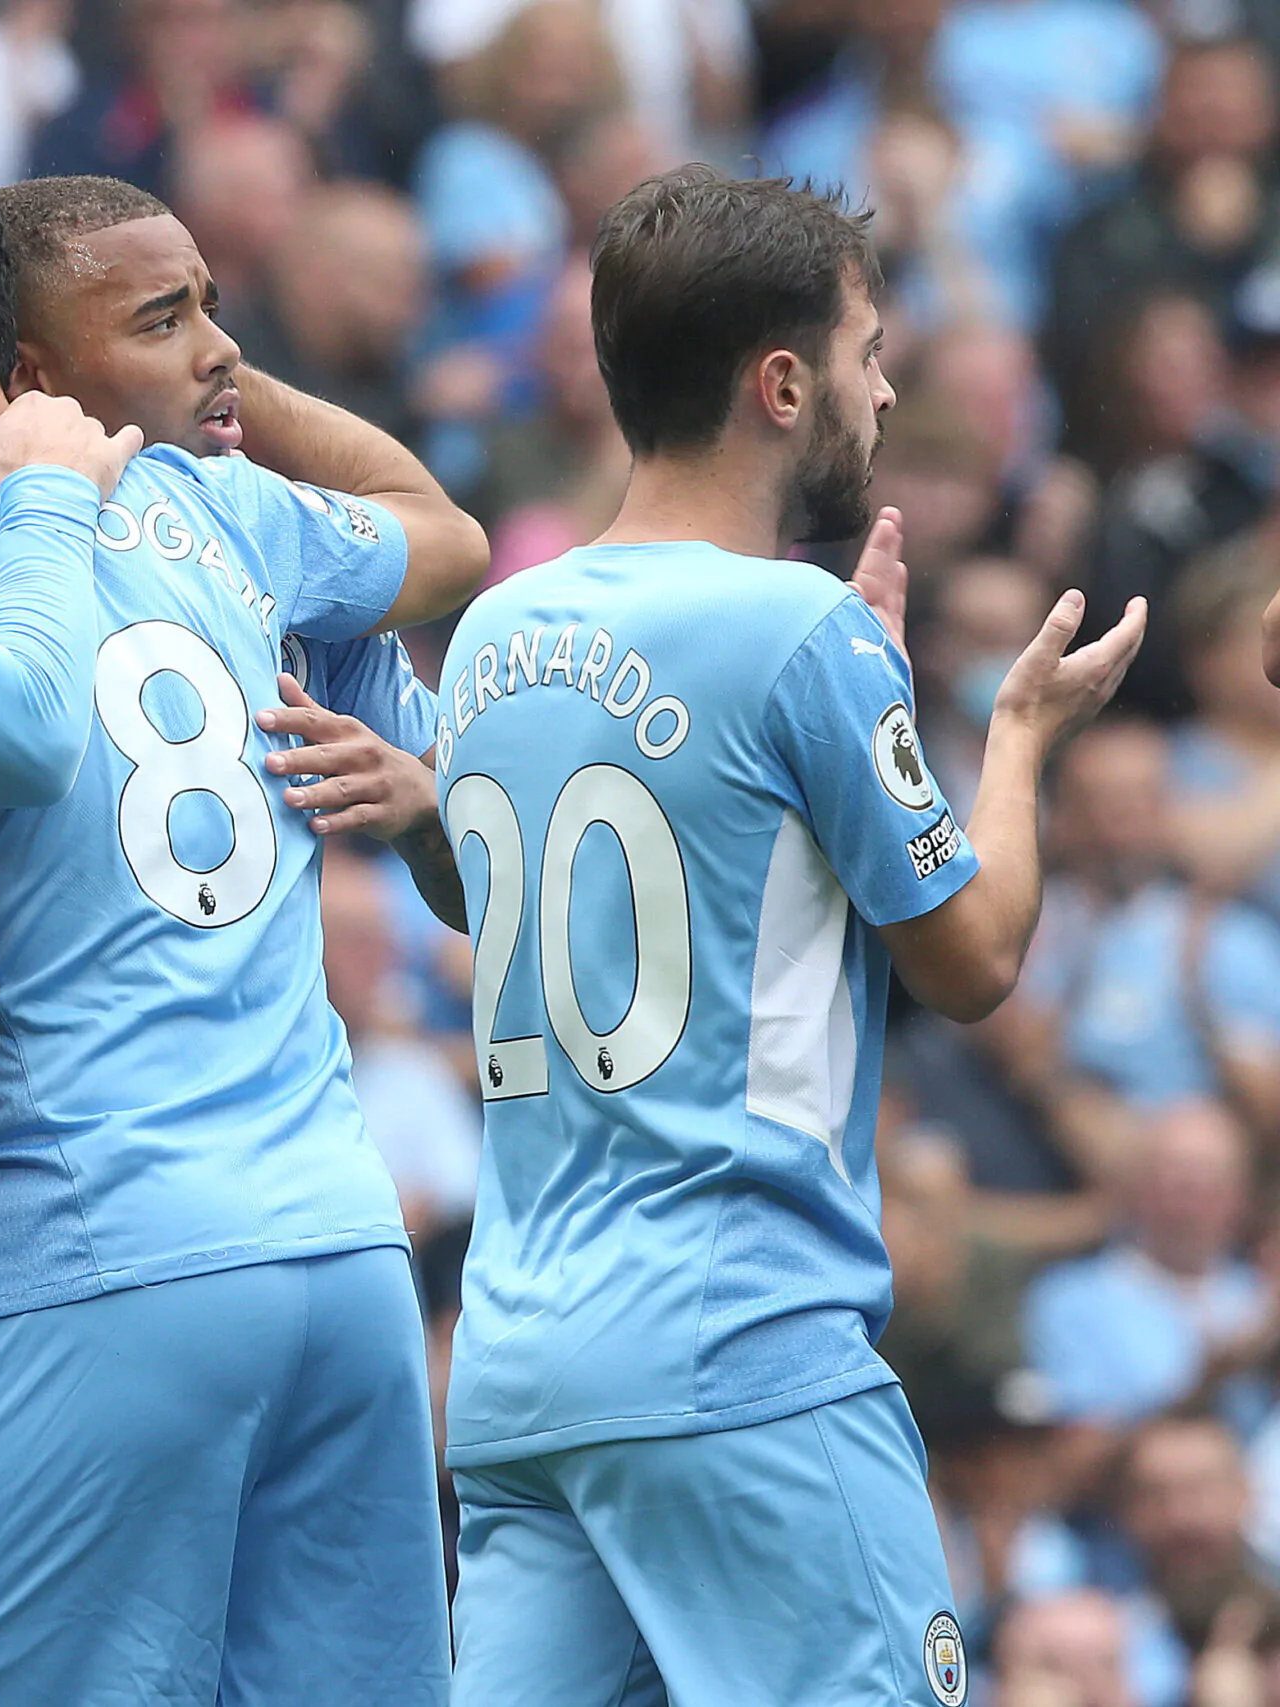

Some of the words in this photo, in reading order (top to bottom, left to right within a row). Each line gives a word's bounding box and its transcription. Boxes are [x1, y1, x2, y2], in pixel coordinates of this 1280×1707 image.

[94, 619, 277, 928] 8
[437, 622, 691, 779] BERNARDO
[906, 837, 932, 860] No
[931, 814, 954, 848] room
[914, 852, 936, 879] for
[446, 762, 692, 1103] 20
